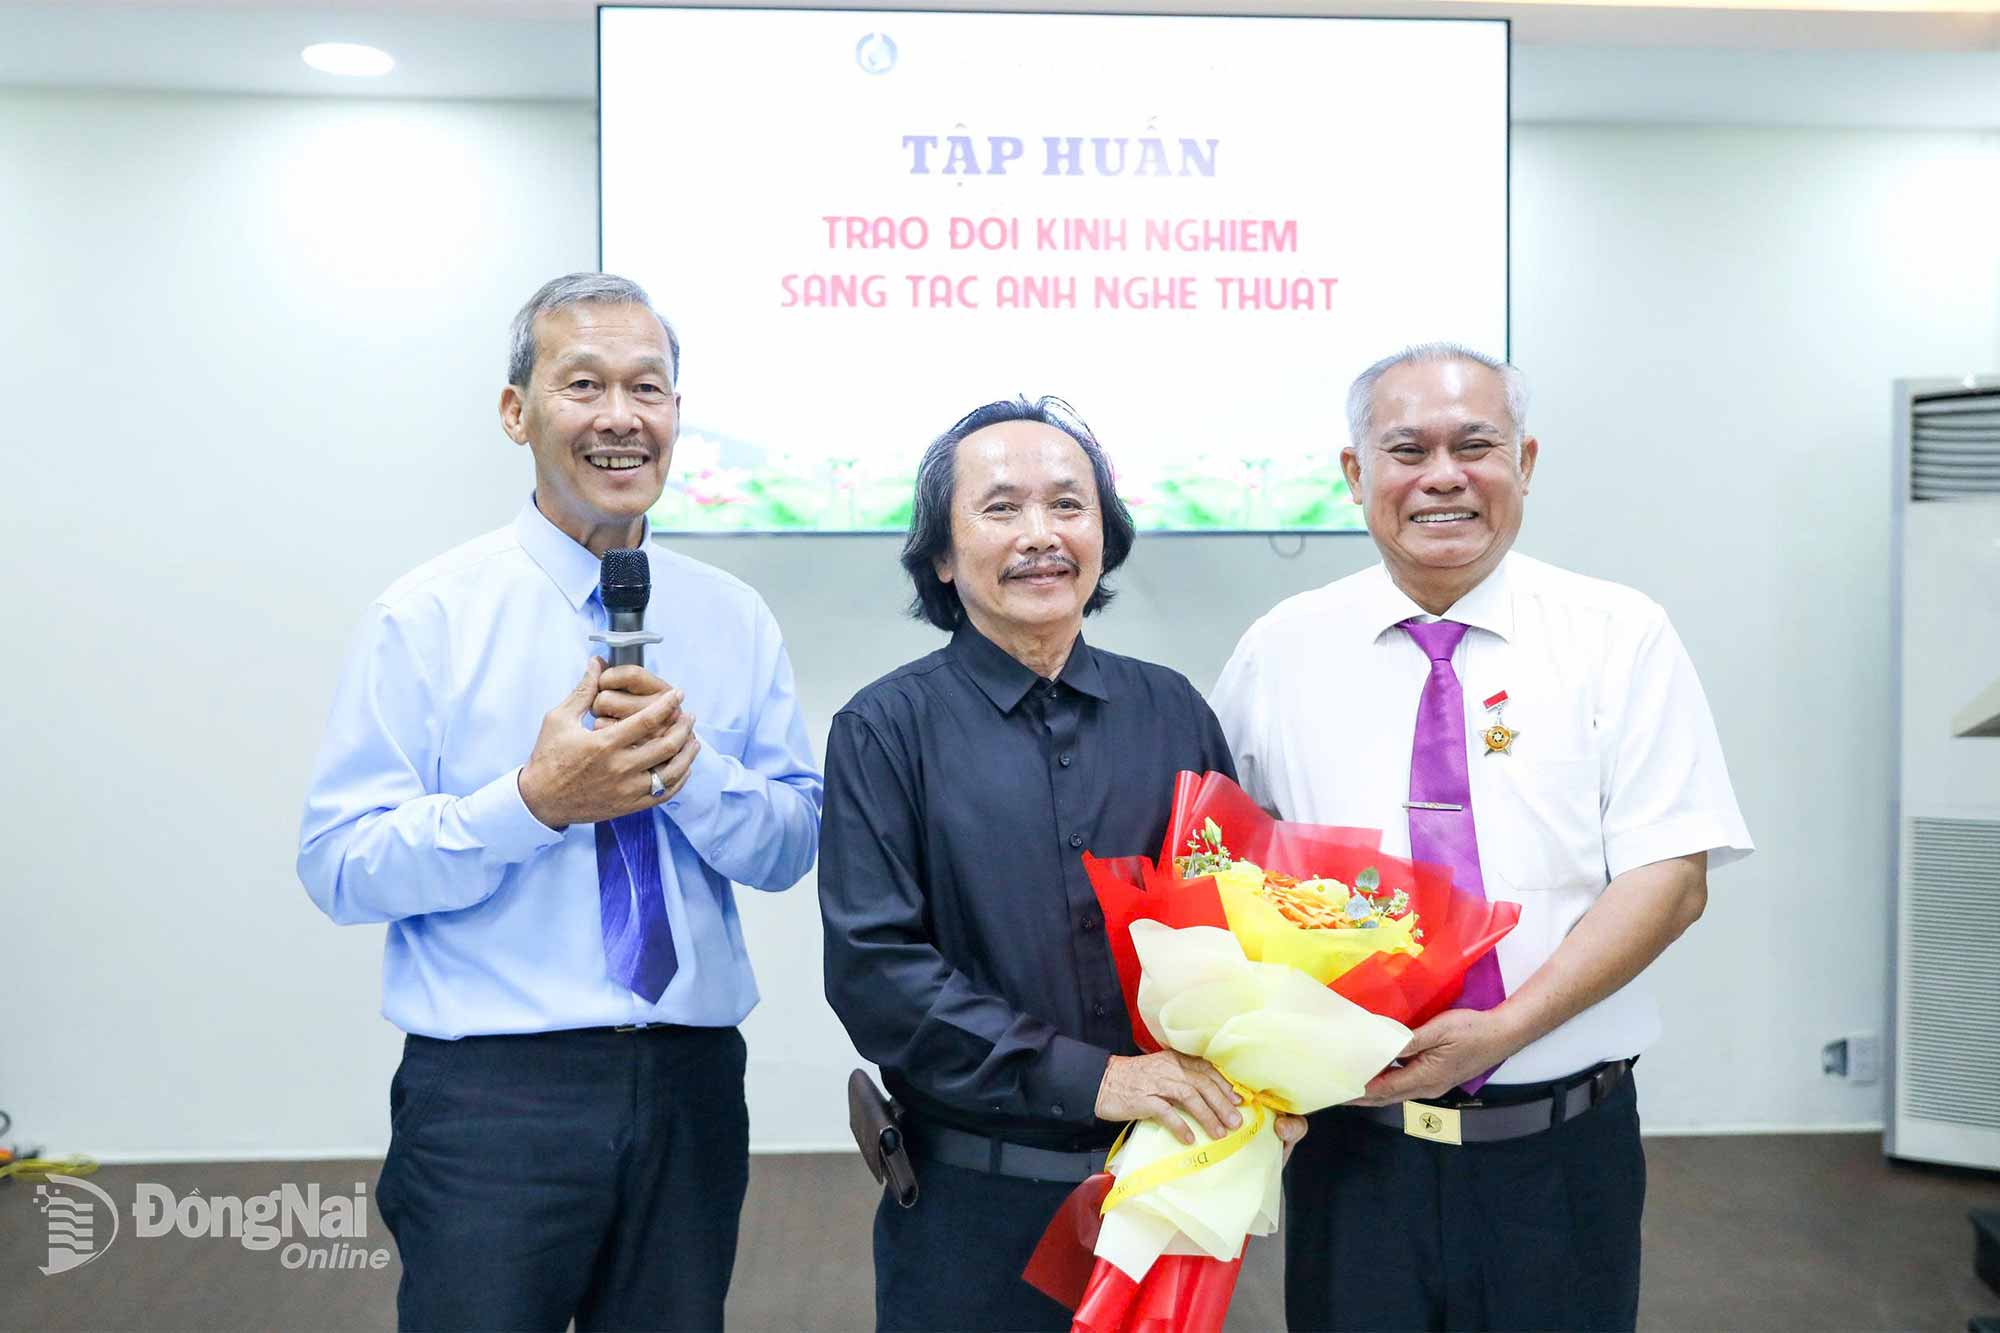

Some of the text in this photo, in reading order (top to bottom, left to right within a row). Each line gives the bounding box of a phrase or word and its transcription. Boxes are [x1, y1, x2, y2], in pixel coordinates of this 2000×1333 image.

[902, 116, 1219, 187] TẬP HUẤN
[822, 216, 930, 251] TRAO
[1036, 217, 1126, 251] KINH
